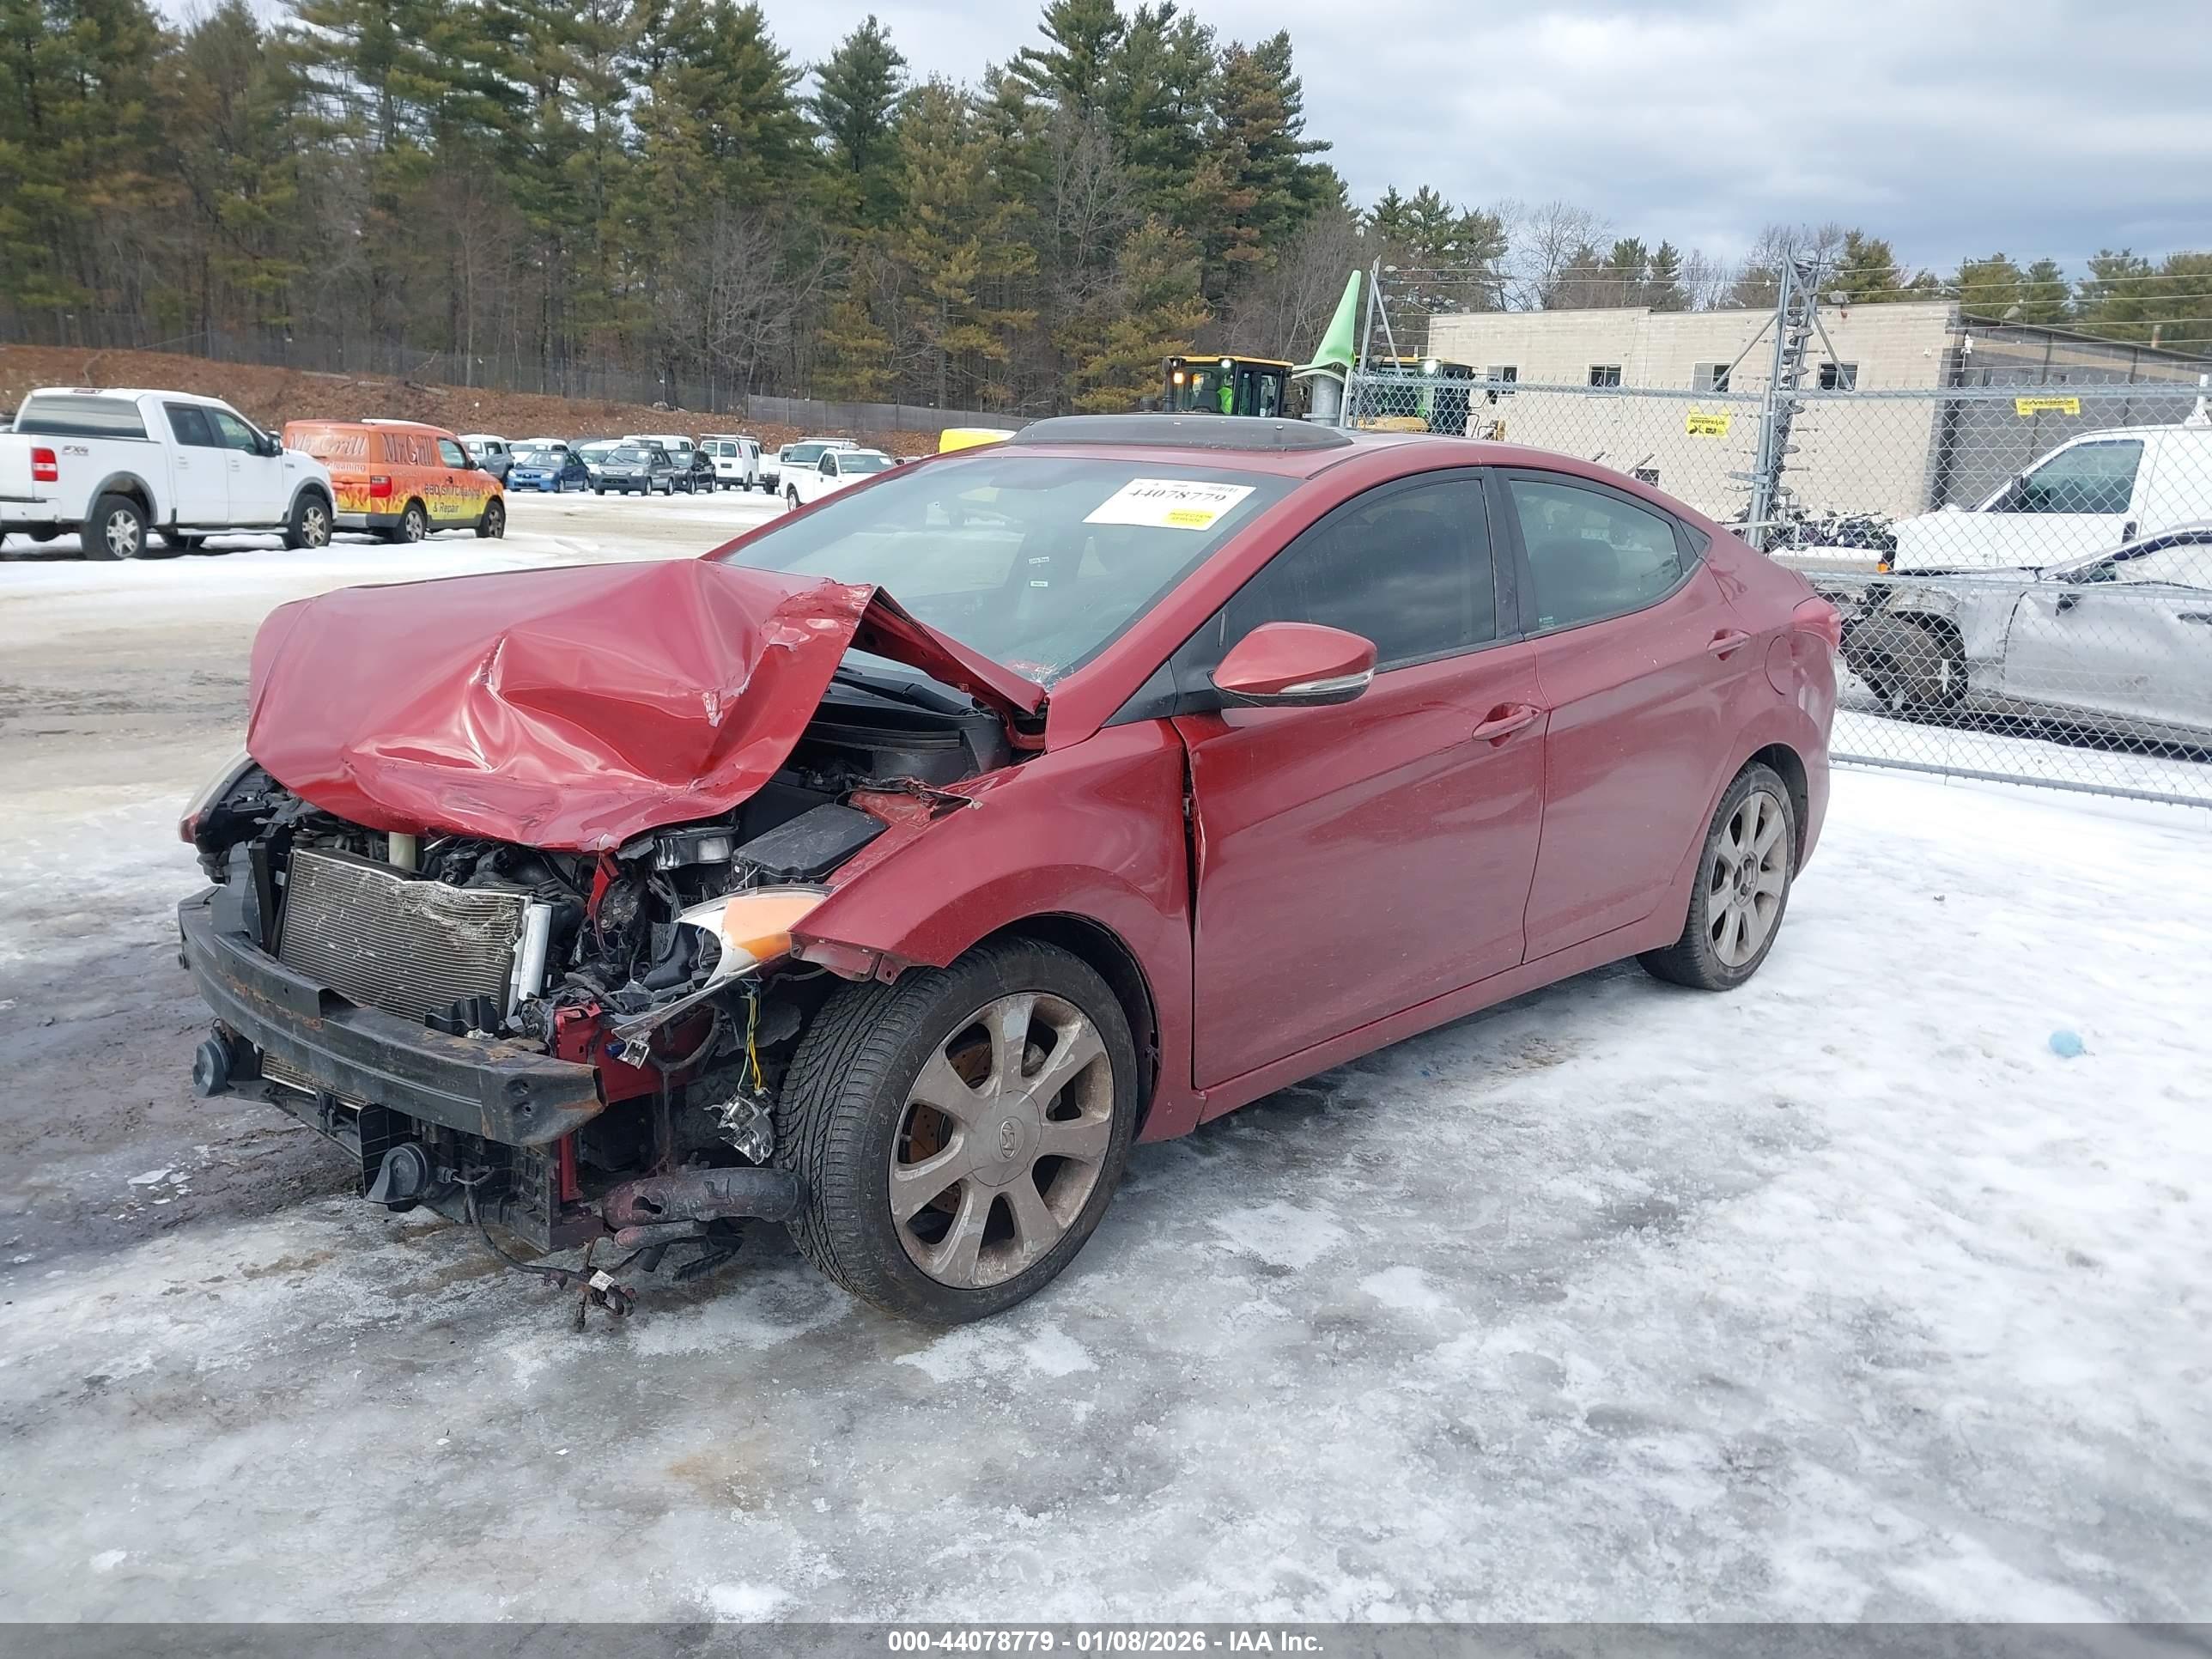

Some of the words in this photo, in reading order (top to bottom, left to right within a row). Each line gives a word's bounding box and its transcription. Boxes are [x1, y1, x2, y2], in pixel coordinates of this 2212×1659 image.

[1128, 489, 1227, 502] 44078779
[433, 501, 439, 513] &
[440, 501, 459, 514] Repair
